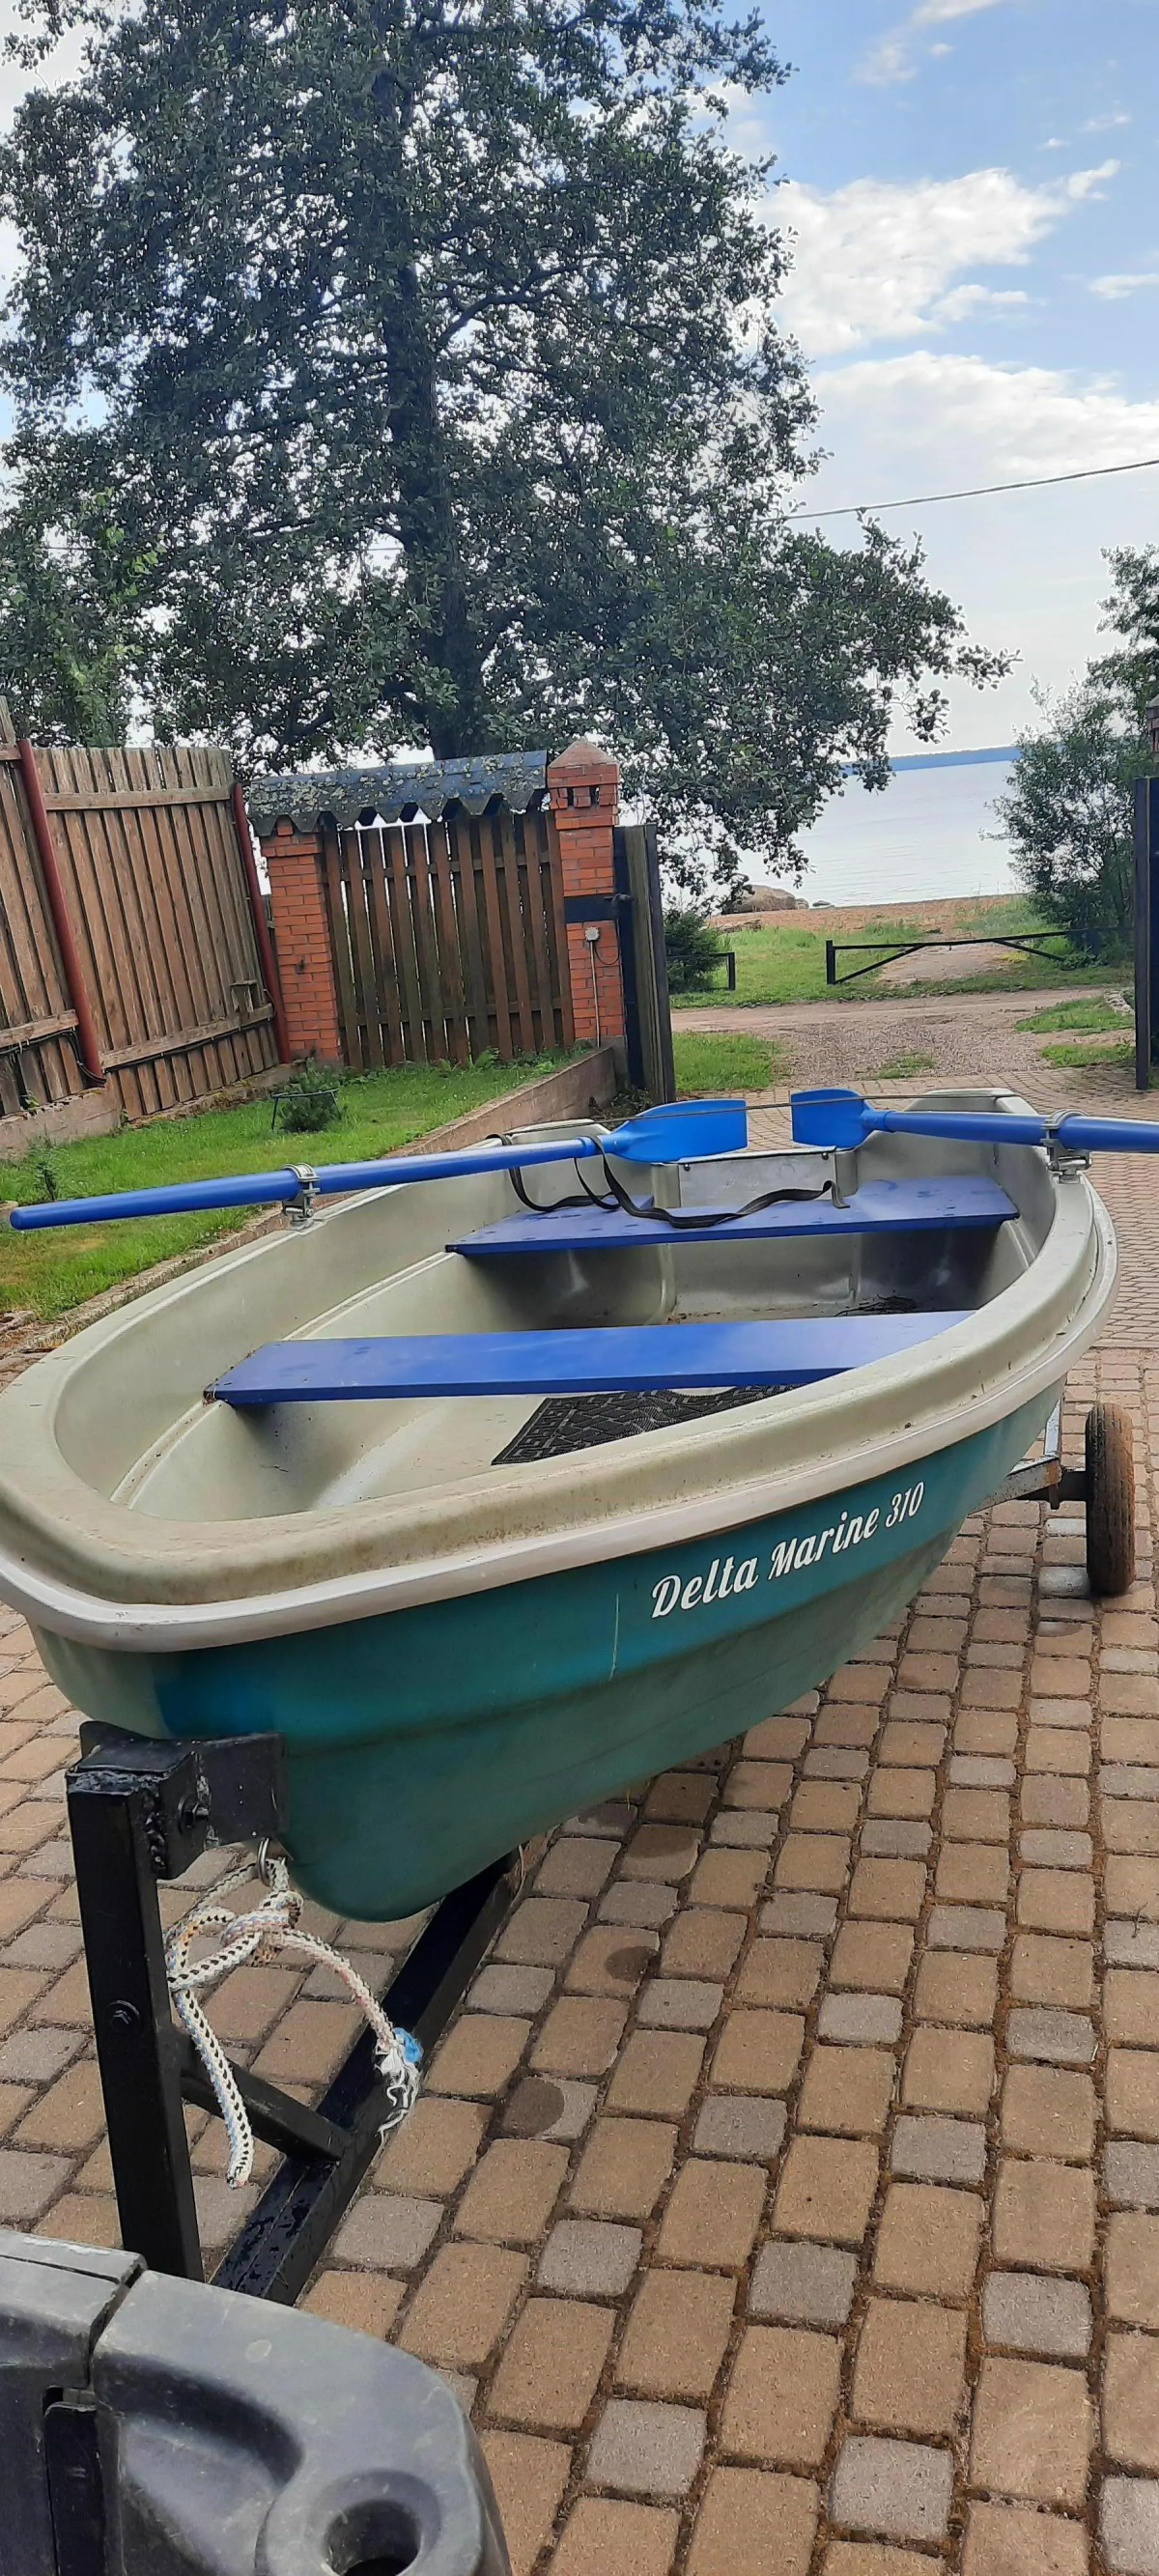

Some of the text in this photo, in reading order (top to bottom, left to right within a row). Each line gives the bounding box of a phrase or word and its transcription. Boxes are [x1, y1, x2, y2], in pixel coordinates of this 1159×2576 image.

[651, 1481, 924, 1619] Delta Marine 310
